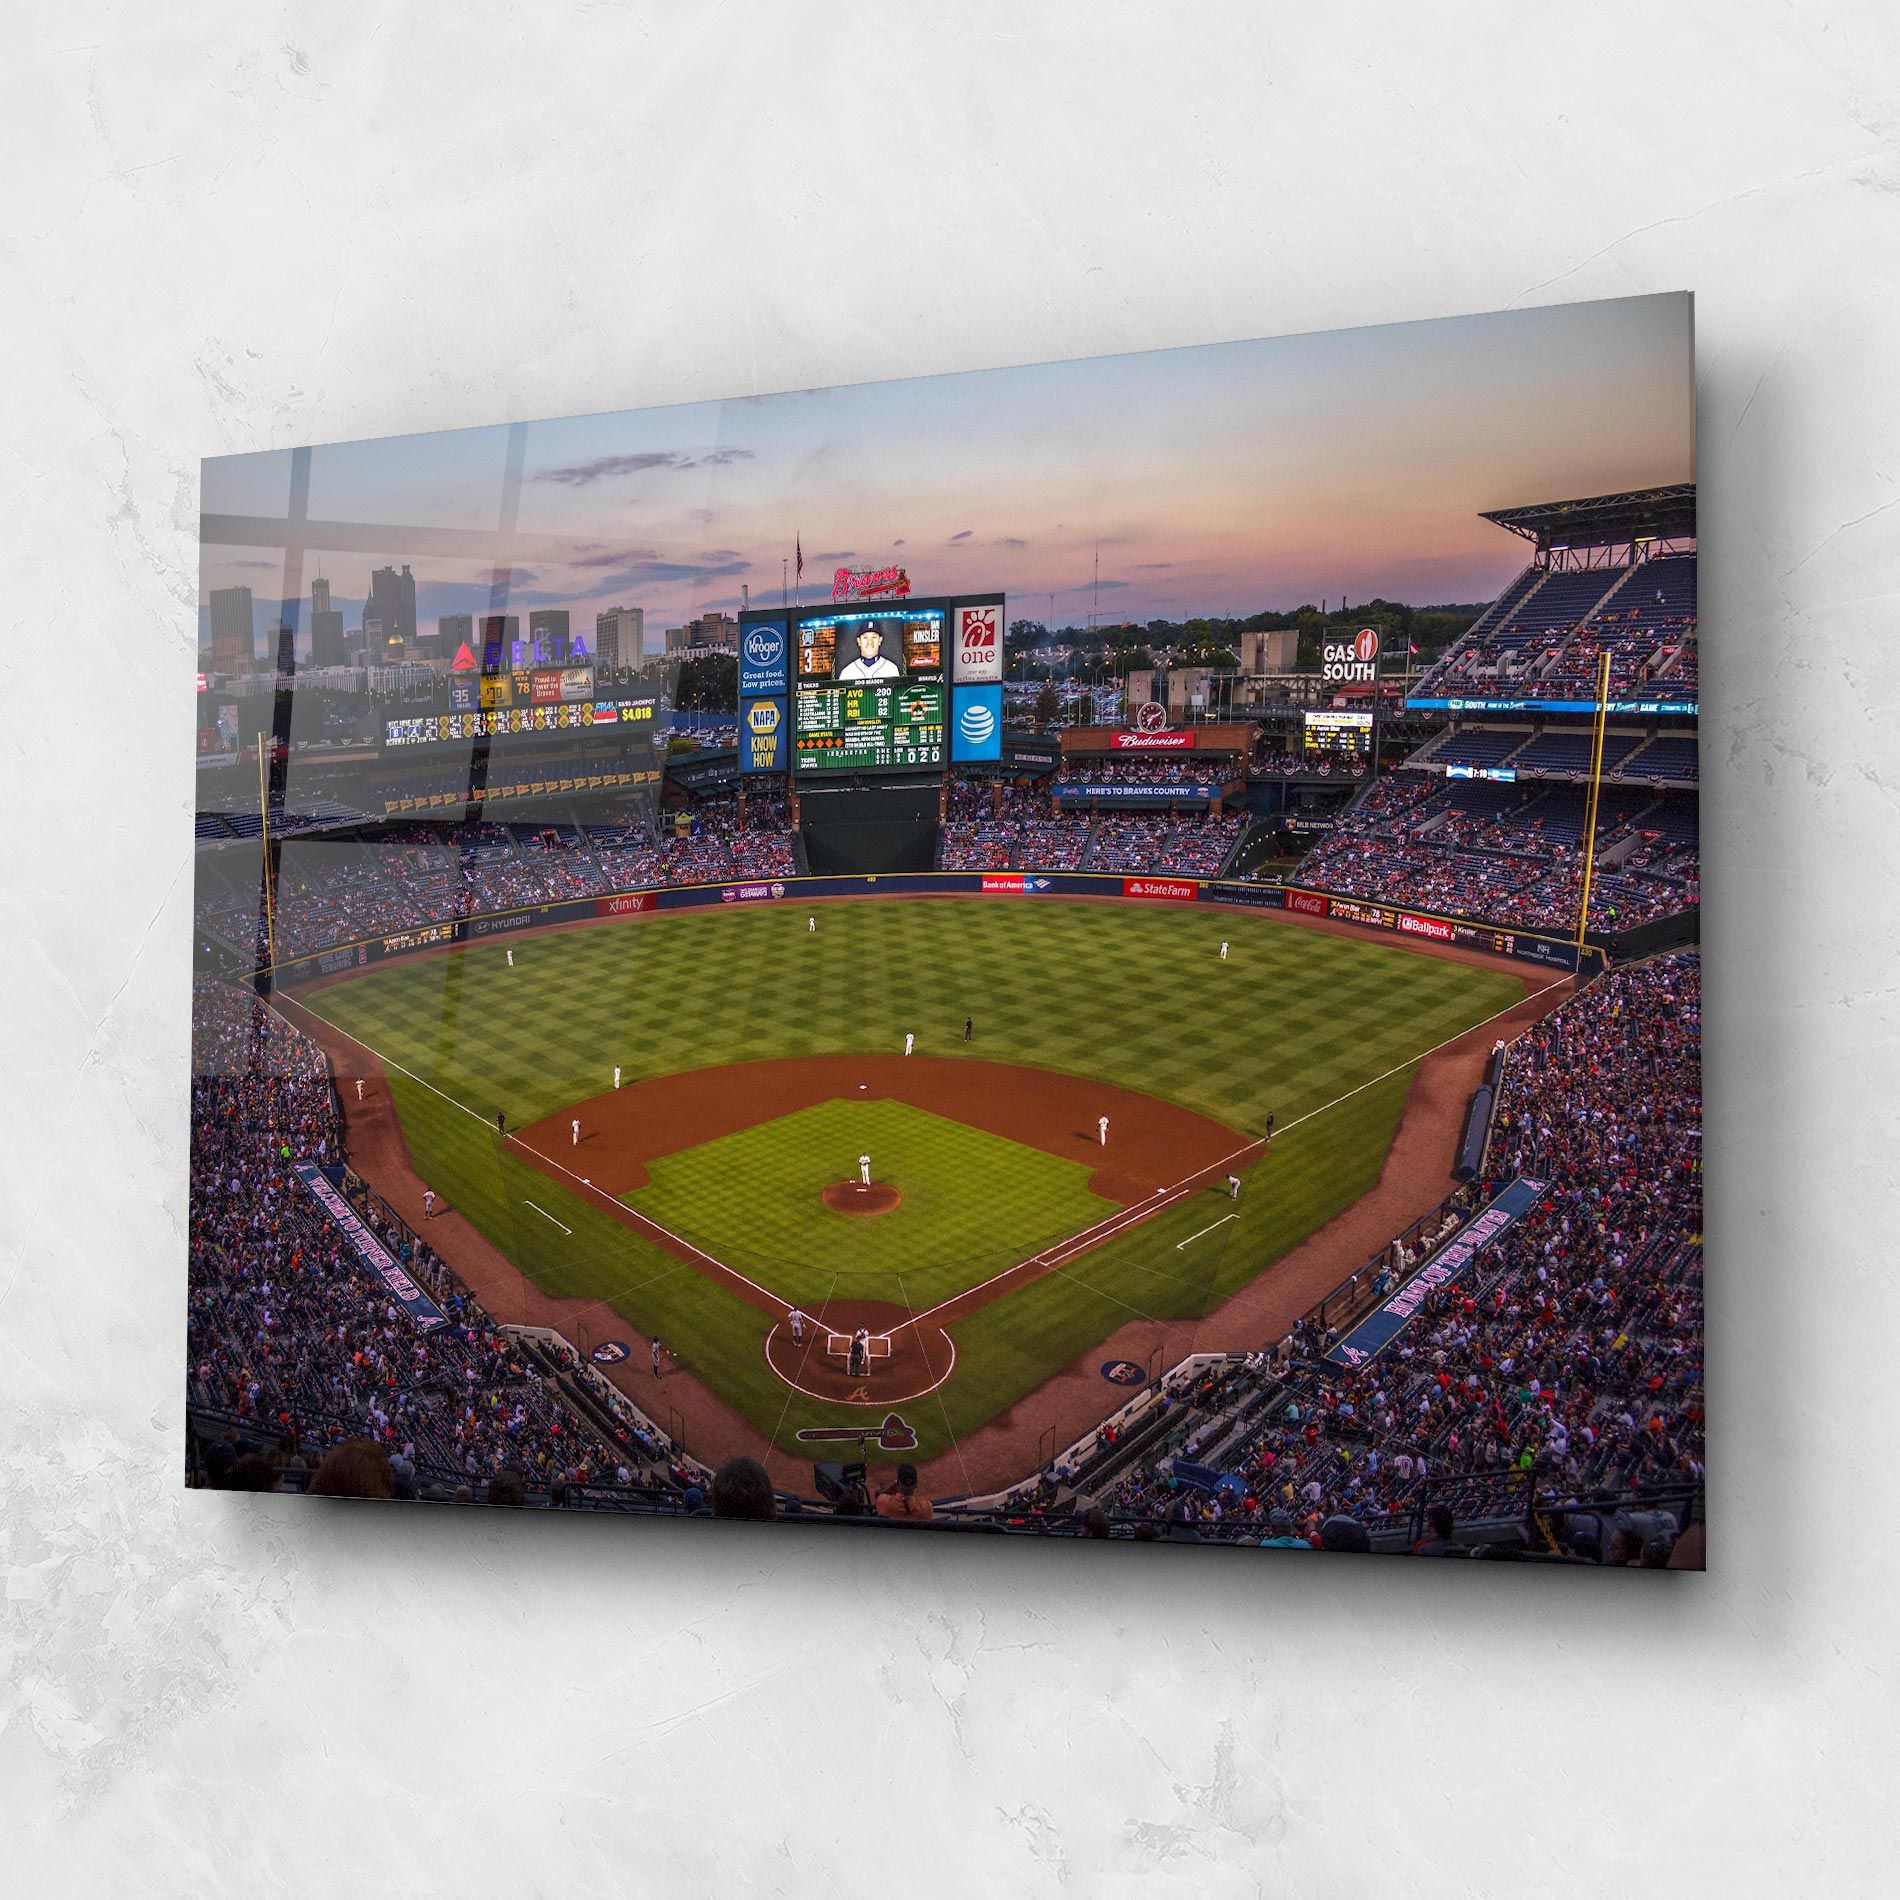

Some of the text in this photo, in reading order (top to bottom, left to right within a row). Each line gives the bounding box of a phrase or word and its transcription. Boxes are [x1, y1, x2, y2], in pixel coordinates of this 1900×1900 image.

[831, 565, 898, 598] Braves
[913, 630, 940, 643] KINSLER
[486, 636, 588, 666] DELTA
[748, 635, 780, 661] Kroger
[1323, 645, 1356, 663] GAS
[804, 649, 813, 673] 3
[961, 650, 995, 664] one
[742, 670, 785, 680] Great food.
[1323, 663, 1376, 681] SOUTH
[517, 682, 530, 695] 78
[759, 680, 786, 689] prices.
[452, 688, 469, 703] $35
[847, 689, 864, 698] AVG
[875, 688, 891, 697] .290
[632, 699, 656, 707] JACKPOT
[847, 700, 859, 709] HR
[878, 698, 888, 707] 28
[1464, 700, 1486, 709] SOUTH
[1640, 703, 1658, 712] GAME
[622, 707, 652, 722] $4,018
[753, 710, 776, 727] NAPA
[847, 709, 860, 718] RBI
[878, 708, 888, 716] 82
[751, 735, 777, 752] KNOW
[1118, 734, 1187, 748] Budweiser
[753, 752, 774, 768] HOW
[908, 750, 940, 763] 0 2 0
[1086, 787, 1112, 795] HERE'S
[1112, 787, 1123, 795] TO
[1123, 787, 1153, 795] BRAVES
[1154, 787, 1191, 795] COUNTRY
[983, 880, 999, 888] Bank
[1006, 881, 1033, 889] America
[1143, 883, 1191, 897] State Farm
[609, 897, 644, 913] xfinity
[1337, 901, 1350, 909] Aaron
[1371, 909, 1381, 918] 78
[491, 915, 531, 930] HYUNDAI
[1411, 919, 1449, 938] Ballpark
[1458, 927, 1477, 936] Kinsler
[1516, 949, 1570, 966] NORTHSIDE HOSPITAL
[1580, 948, 1593, 957] 330
[308, 1176, 421, 1302] WELCOME TO TURNER FIELD
[1383, 1208, 1511, 1319] HOME OF THE BRAVES
